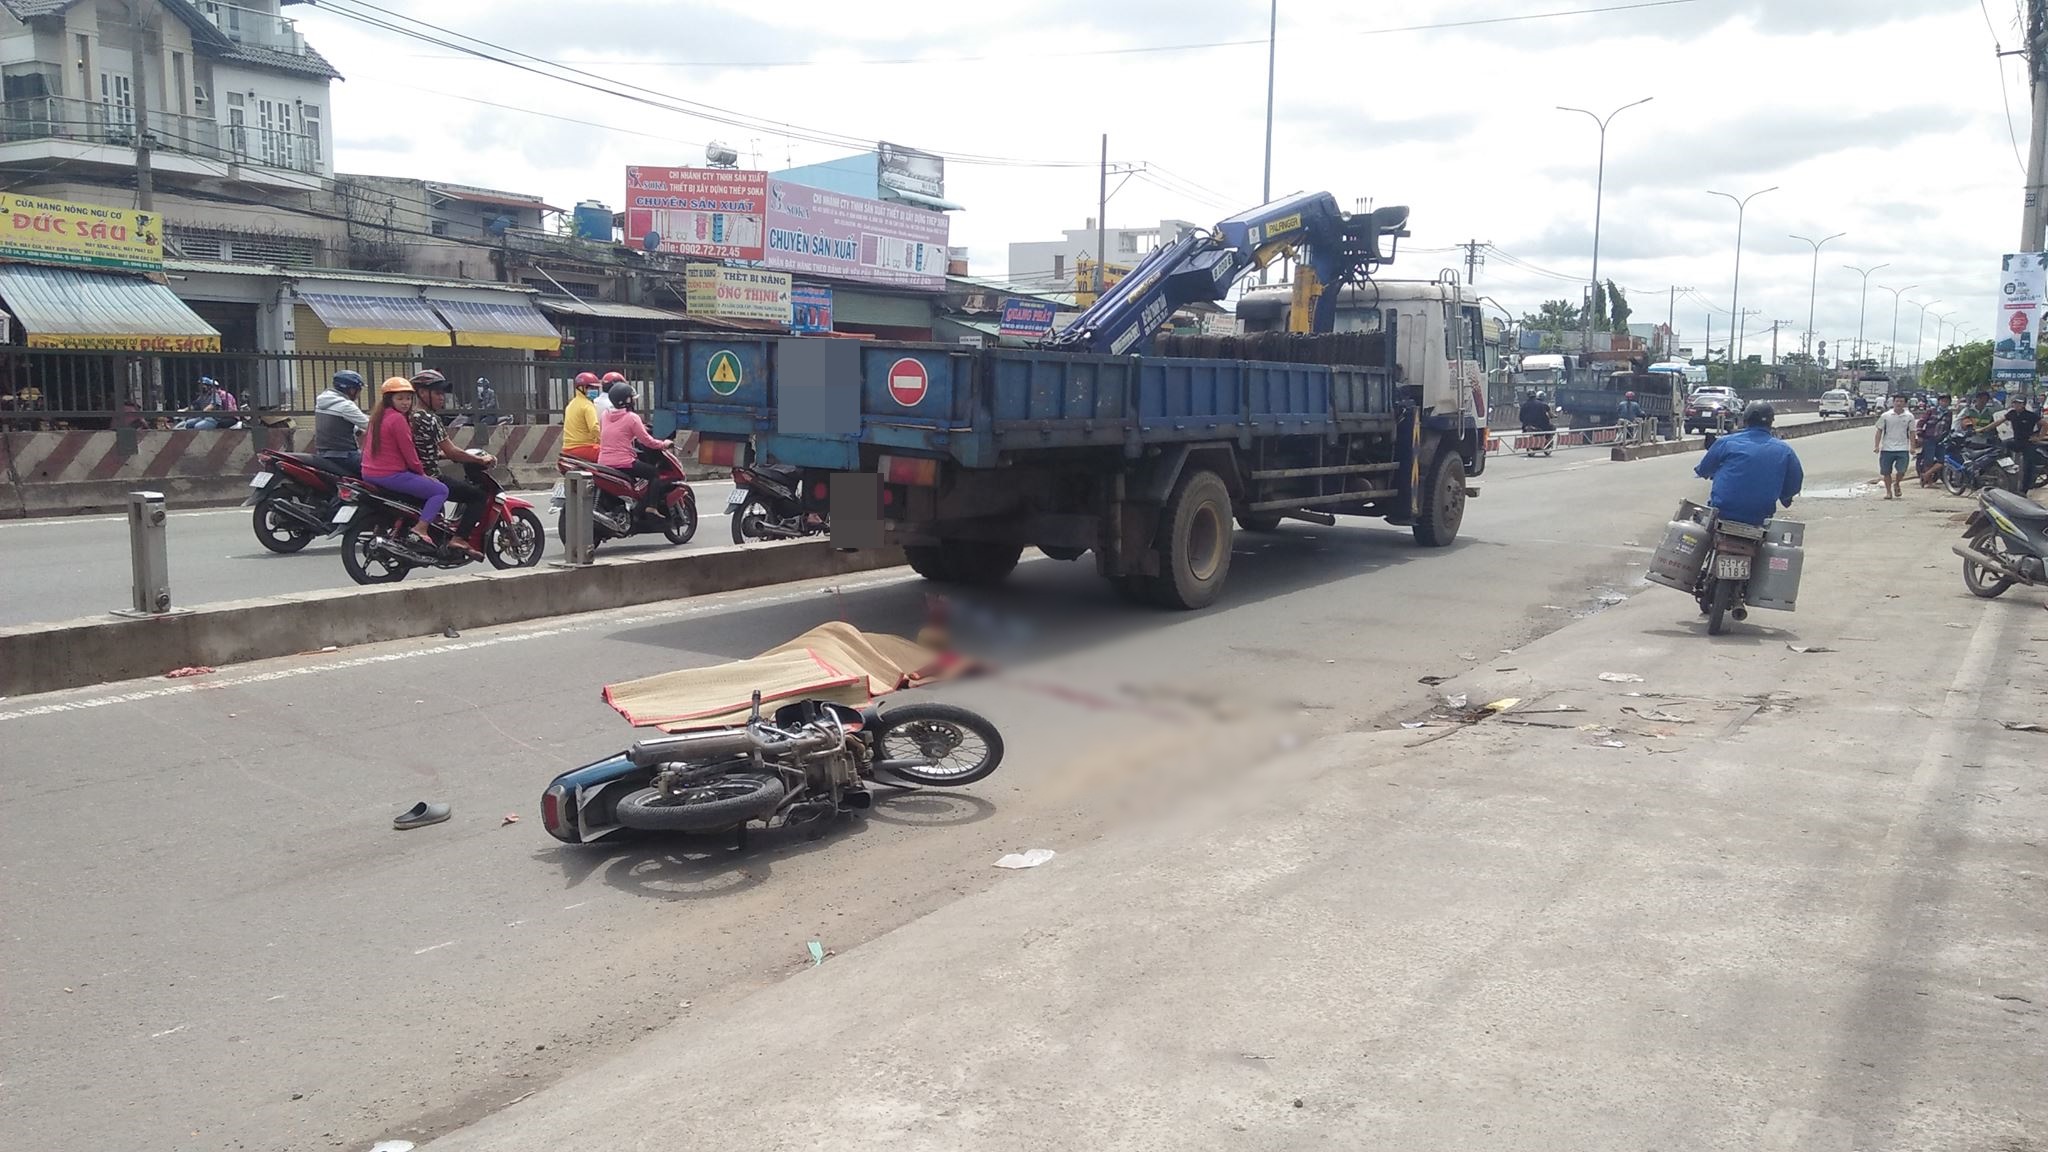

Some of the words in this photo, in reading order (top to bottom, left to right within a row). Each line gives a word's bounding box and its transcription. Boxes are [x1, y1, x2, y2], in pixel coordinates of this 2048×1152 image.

[669, 171, 679, 179] CHI
[702, 172, 714, 181] CTY
[716, 173, 733, 182] TNHH
[670, 181, 687, 192] THIẾT
[747, 186, 764, 196] SOKA
[637, 196, 687, 208] CHUYÊN
[691, 197, 716, 209] SẢN
[721, 199, 754, 211] XUẤT
[12, 212, 66, 234] ĐỨC
[76, 219, 126, 241] SÁU
[680, 244, 740, 257] 0902.72.72.45
[770, 227, 809, 253] CHUYÊN
[812, 230, 831, 257] SẢN
[833, 234, 857, 260] XUẤT
[1721, 567, 1746, 577] 1183
